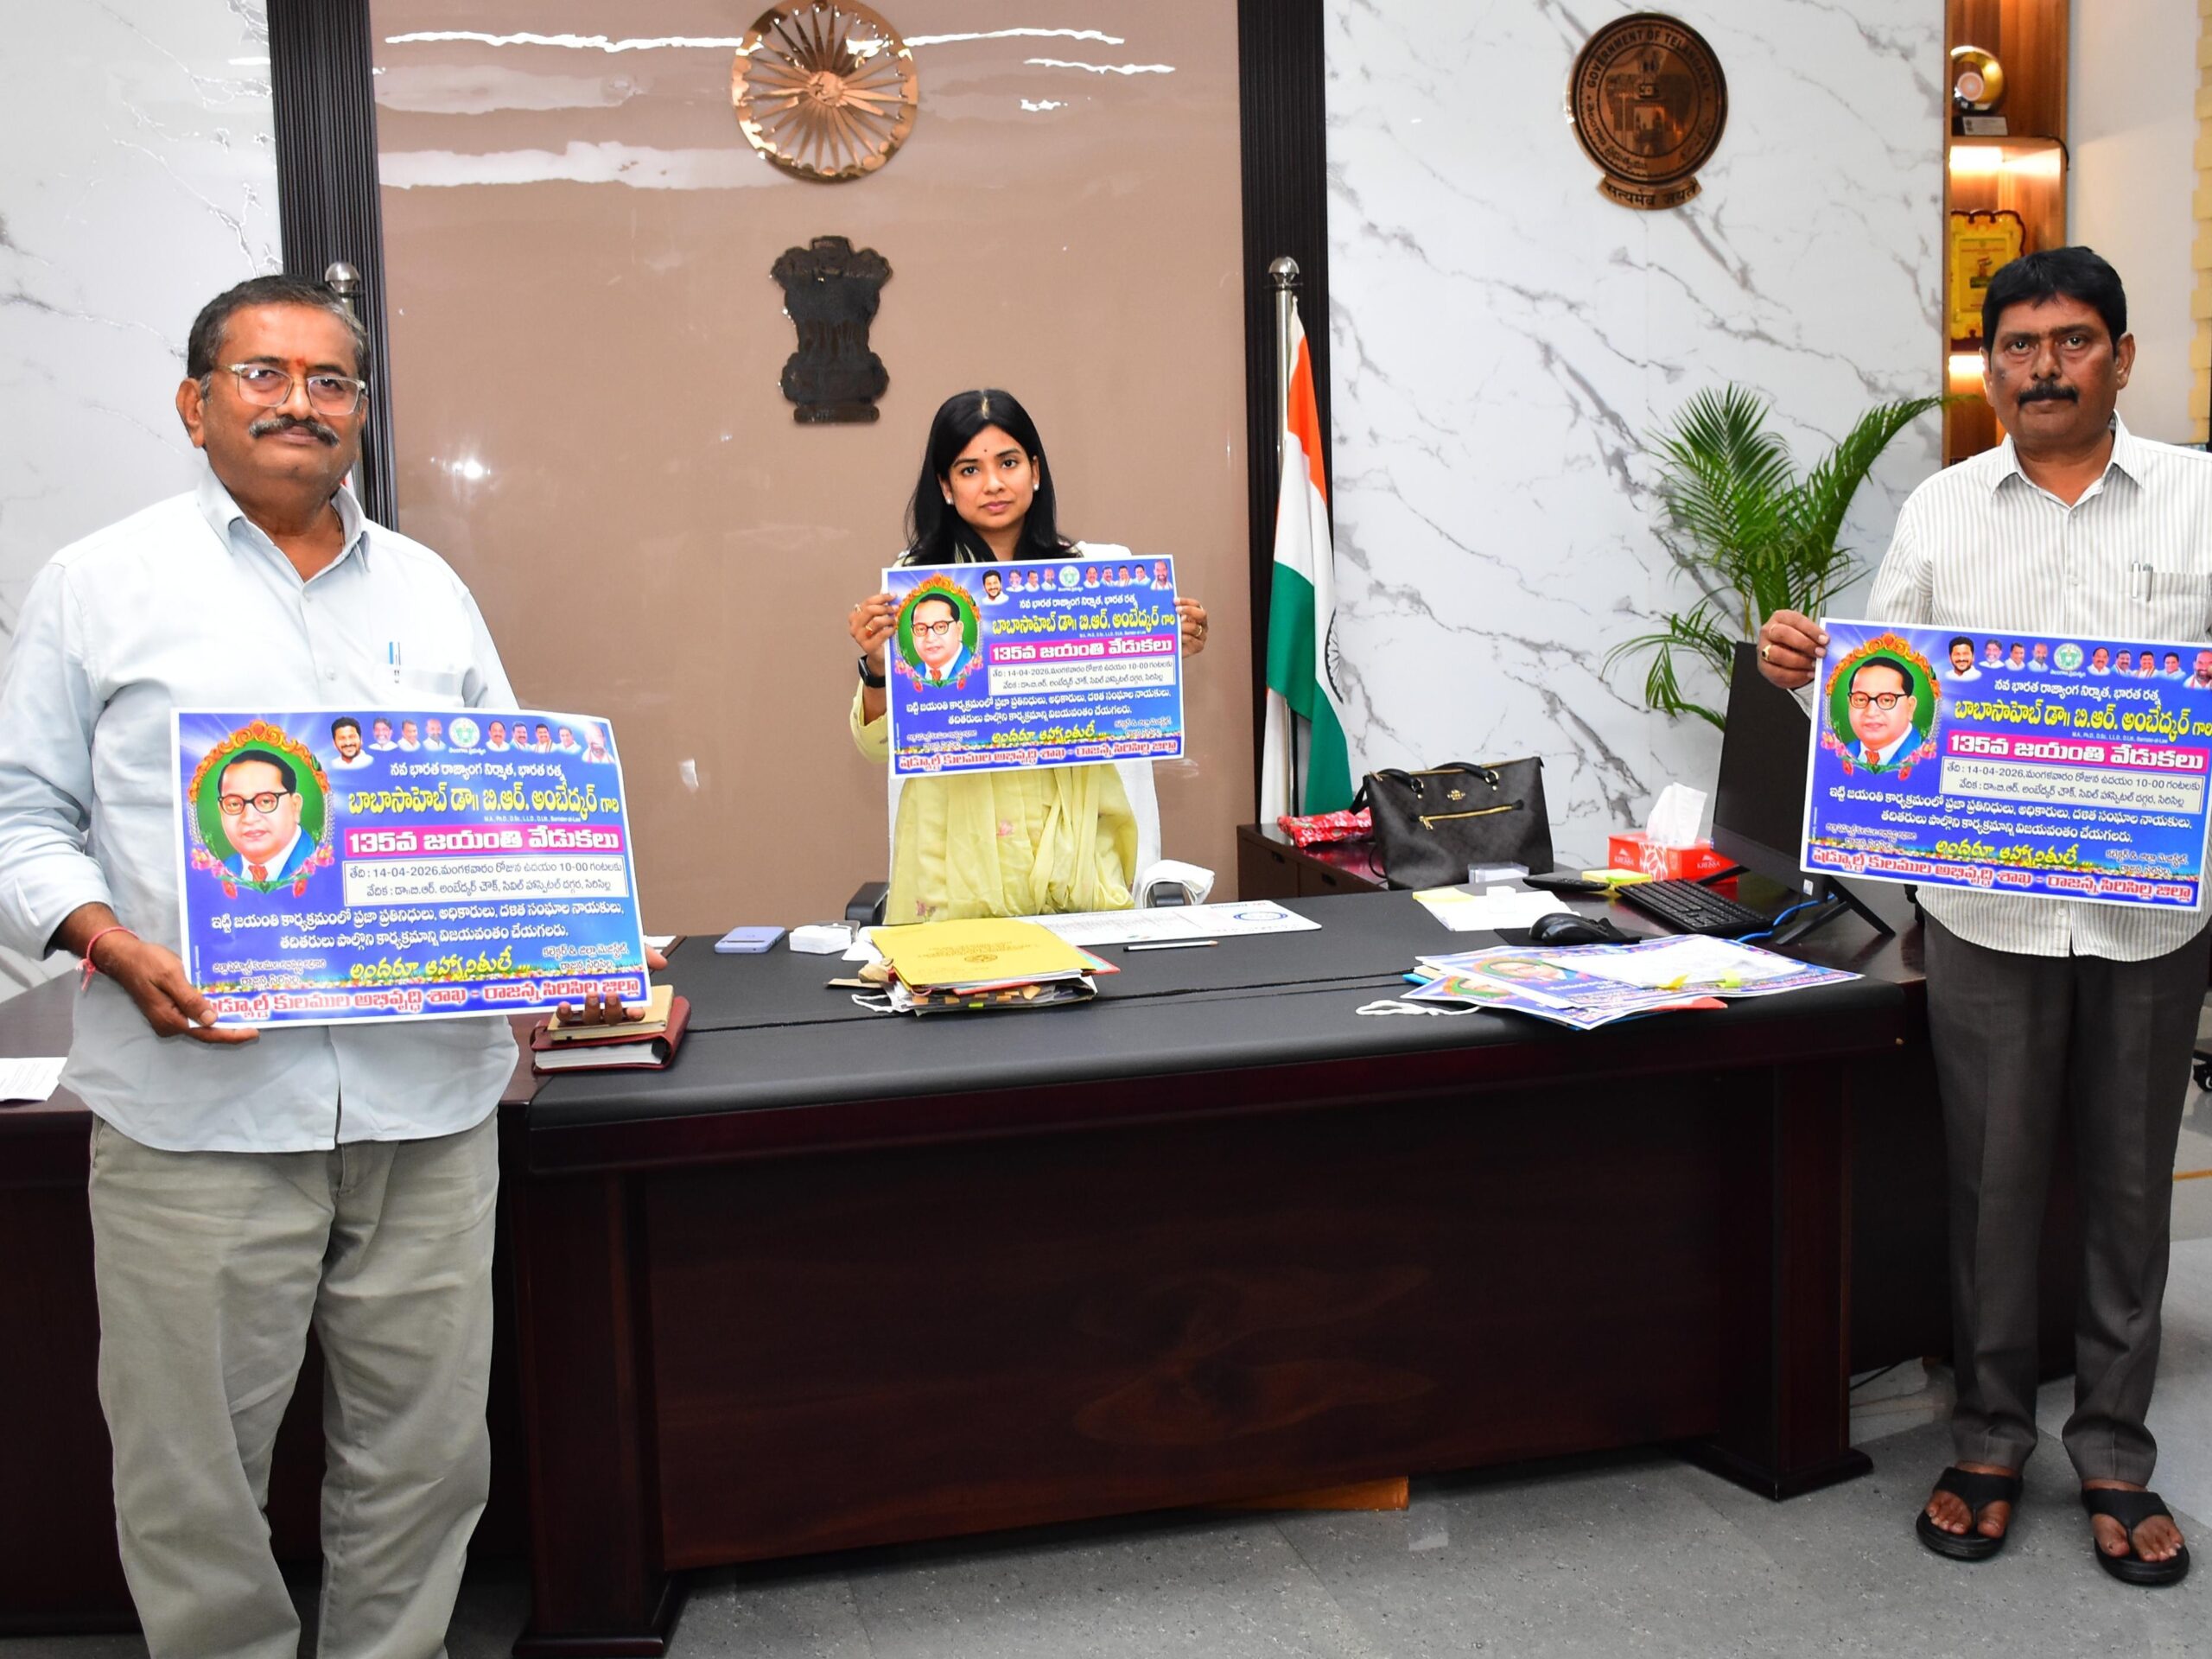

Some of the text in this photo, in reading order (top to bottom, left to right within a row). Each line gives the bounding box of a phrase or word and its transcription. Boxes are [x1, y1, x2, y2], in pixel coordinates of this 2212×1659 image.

[1587, 30, 1711, 89] GOVERNMENT OF TELANGANA
[993, 637, 1172, 659] 135వ జయంతి వేడుకలు
[1955, 699, 2043, 723] బాబాసాహెబ్
[2074, 703, 2119, 729] బి.ఆర్.
[2121, 705, 2189, 742] అంబేద్కర్
[1951, 735, 2203, 768] 135వ జయంతి వేడుకలు
[1847, 789, 1884, 801] జయంతి
[2136, 779, 2164, 788] 10-00
[531, 781, 596, 821] అంబేద్కర్
[350, 824, 618, 852] 135వ జయంతి వేడుకలు
[560, 861, 588, 871] 10-00
[1814, 847, 1865, 871] షెడ్యూల్డ్
[1867, 855, 1931, 874] కులముల
[1935, 864, 1993, 886] అభివృద్ధి
[1997, 871, 2031, 885] శాఖ
[2048, 875, 2099, 893] రాజన్న
[2101, 878, 2152, 898] సిరిసిల్ల
[2156, 885, 2190, 900] జిల్లా
[233, 914, 279, 927] జయంతి
